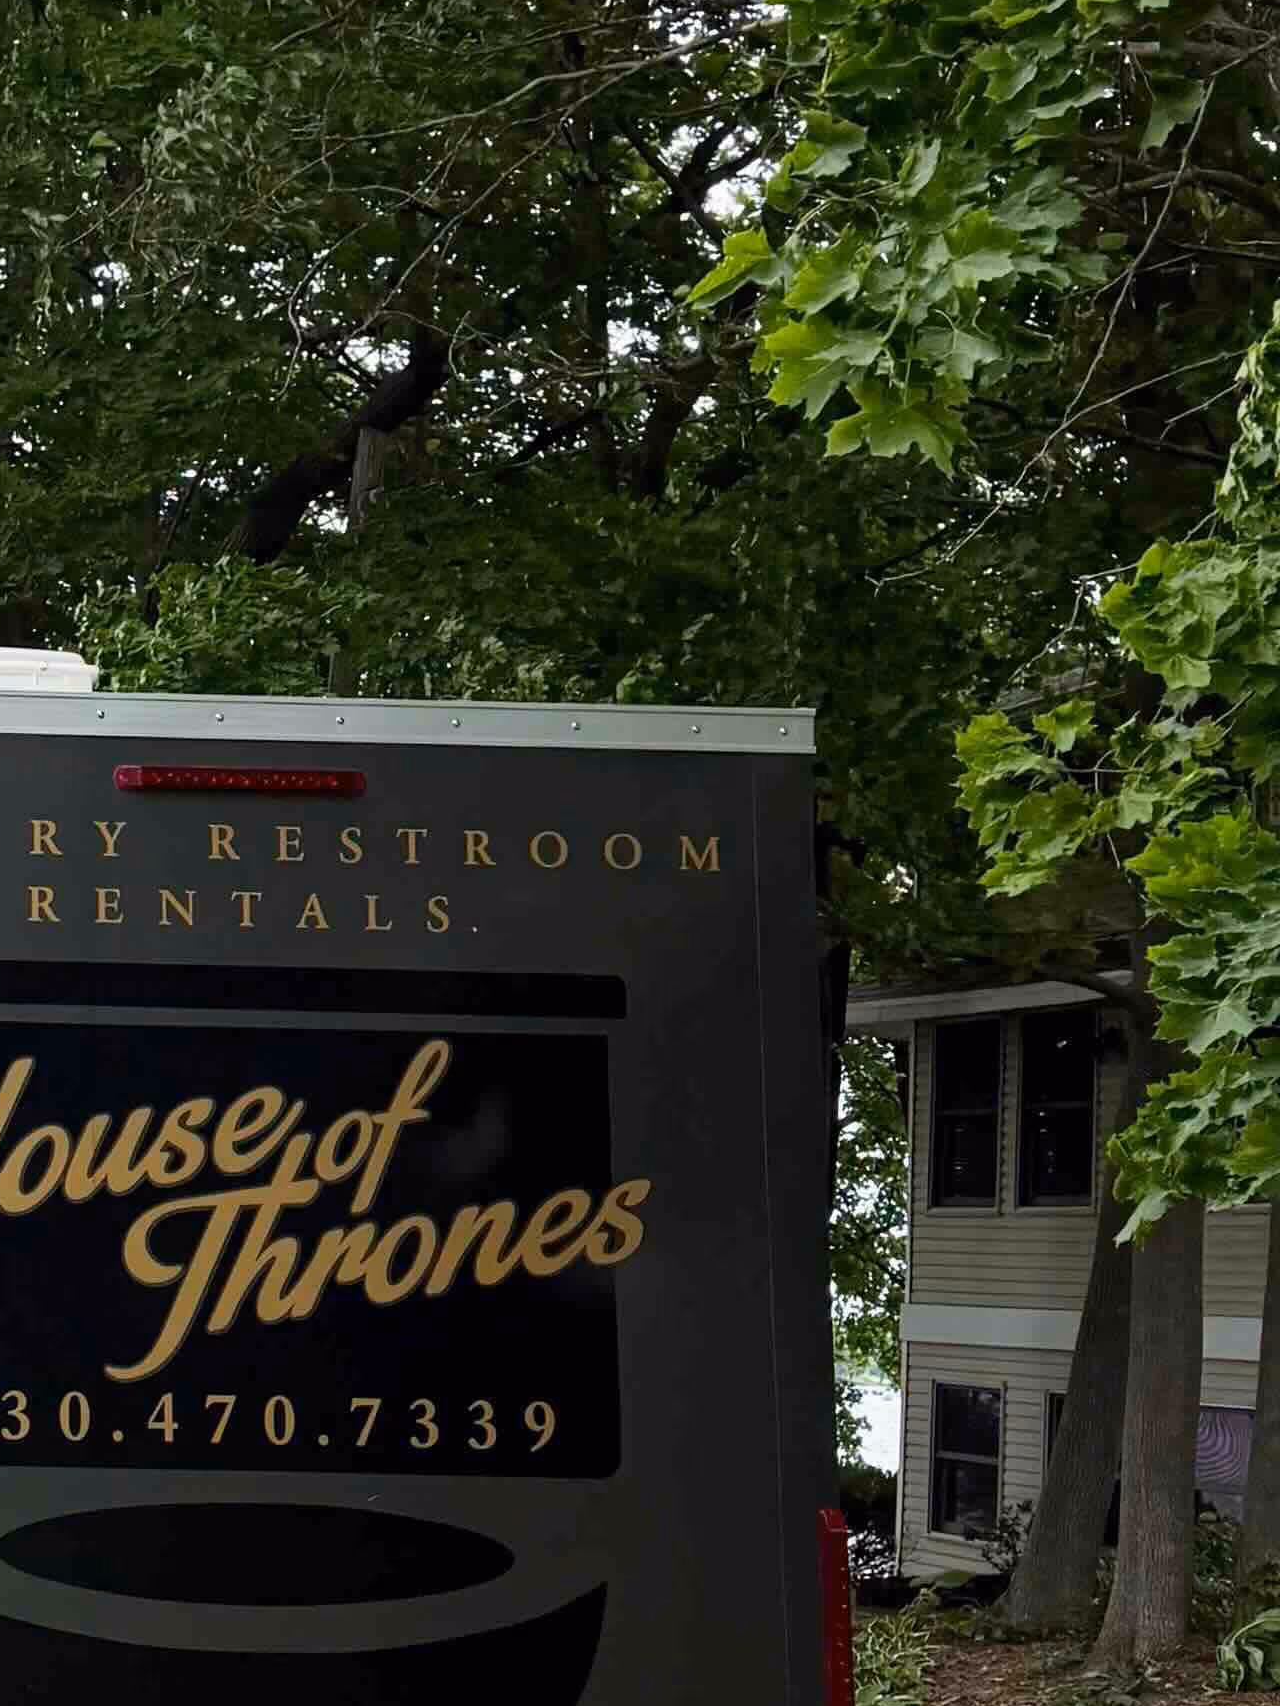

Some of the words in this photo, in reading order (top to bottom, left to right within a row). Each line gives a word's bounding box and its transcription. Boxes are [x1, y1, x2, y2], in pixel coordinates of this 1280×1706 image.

[207, 824, 722, 874] RESTROOM
[312, 1039, 452, 1214] of
[104, 1132, 653, 1382] Thrones
